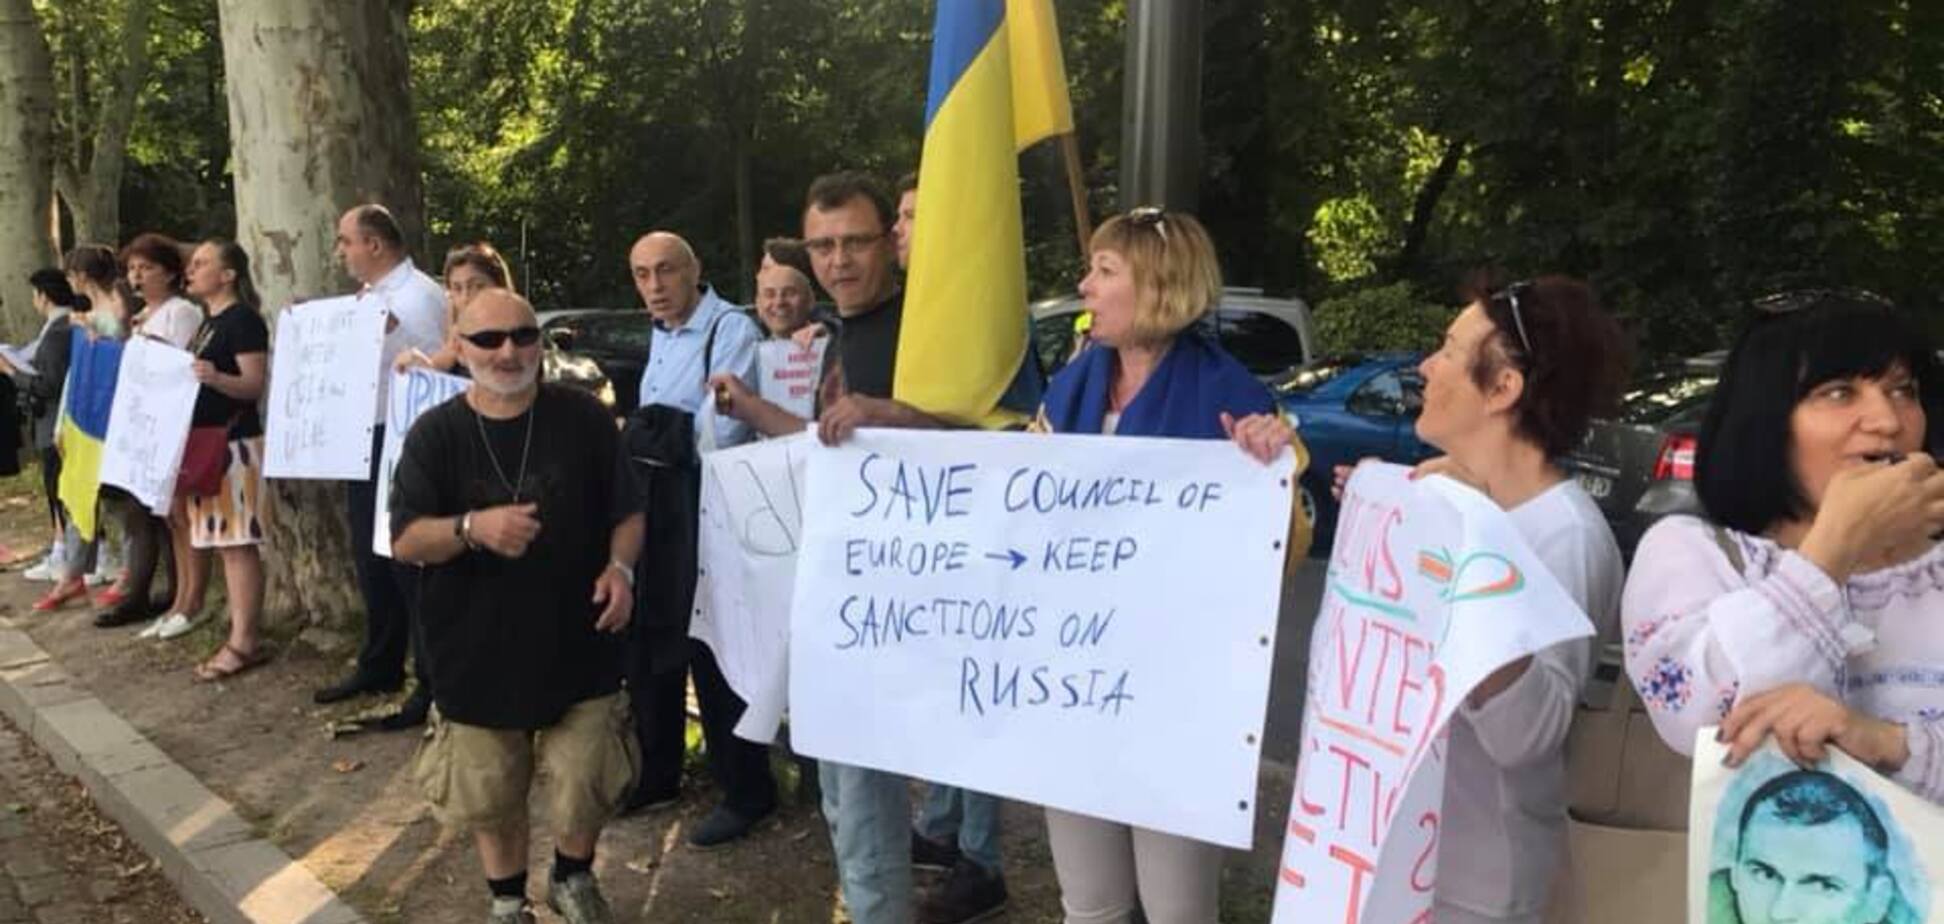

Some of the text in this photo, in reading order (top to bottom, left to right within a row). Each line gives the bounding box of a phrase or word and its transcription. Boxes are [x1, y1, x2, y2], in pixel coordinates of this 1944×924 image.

[851, 453, 978, 525] SAVE
[1004, 467, 1162, 514] COUNCIL
[1178, 481, 1223, 512] OF
[846, 537, 1139, 576] EUROPE KEEP
[835, 596, 1116, 650] SANCTIONS ON
[960, 656, 1135, 715] RUSSIA
